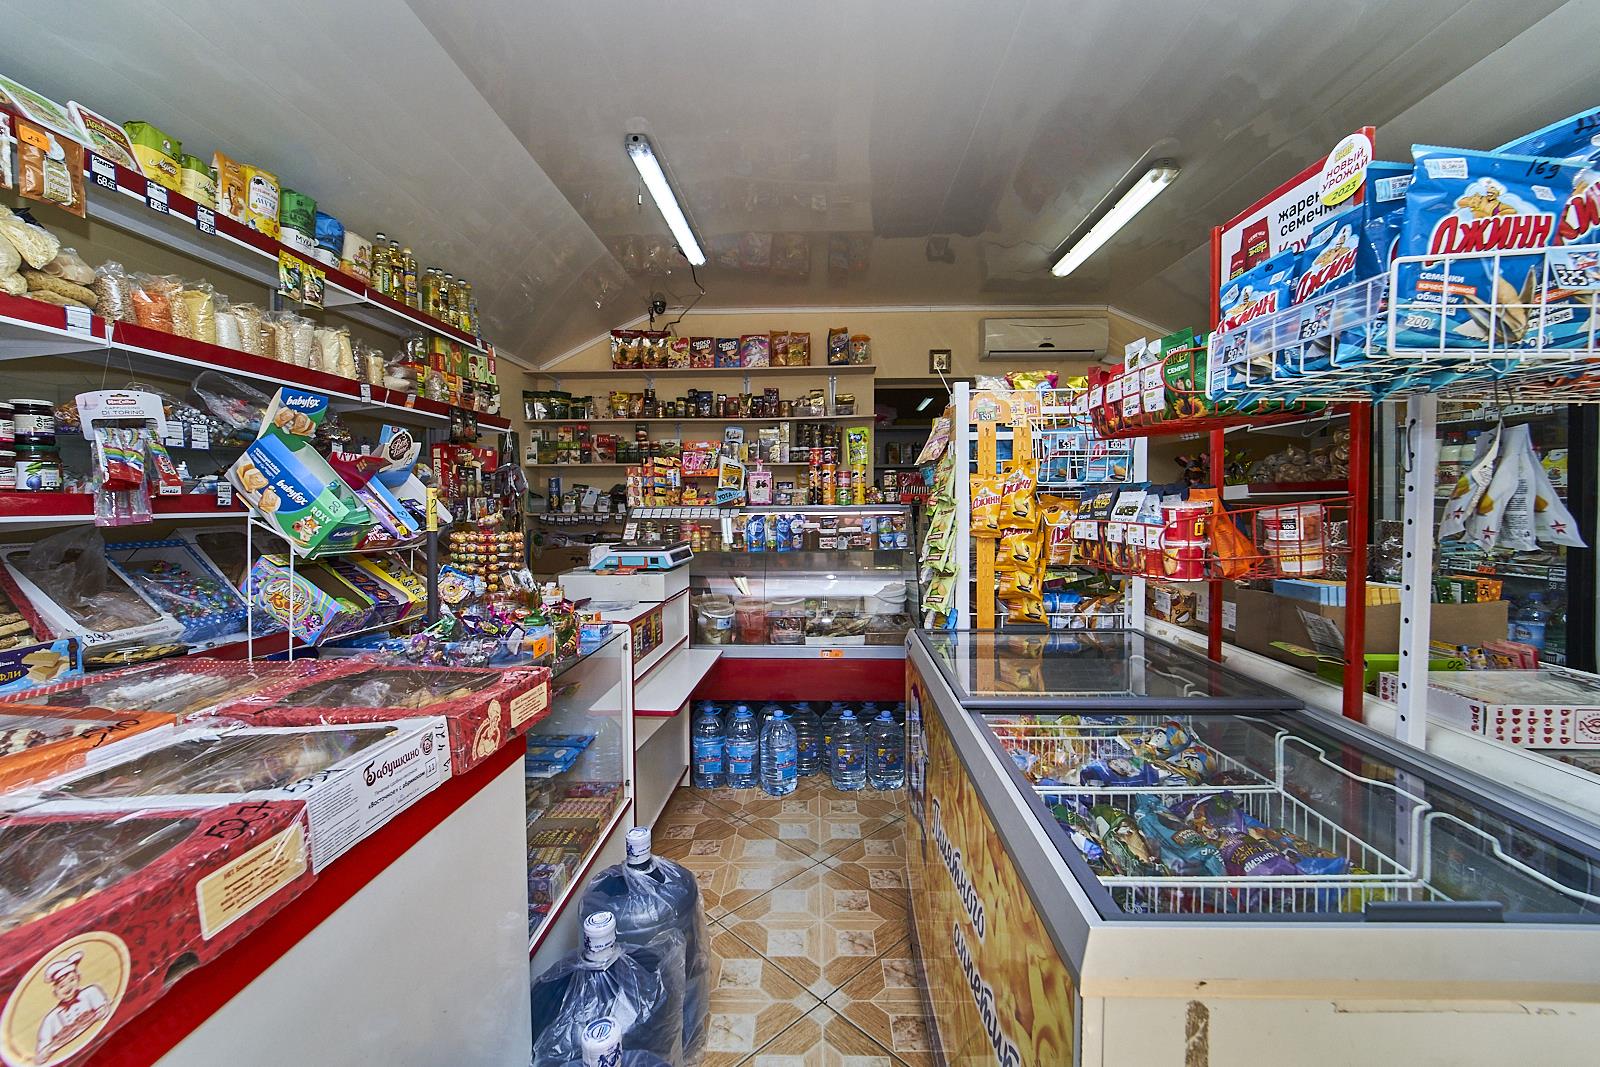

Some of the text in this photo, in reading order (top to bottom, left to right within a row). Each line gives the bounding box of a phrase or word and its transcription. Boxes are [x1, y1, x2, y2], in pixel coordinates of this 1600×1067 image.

[1322, 155, 1368, 192] УРОЖАЙ
[1326, 147, 1365, 180] НОВЫЙ
[1331, 180, 1357, 201] 2023
[1424, 213, 1553, 267] Джинн
[1420, 272, 1464, 283] семеки
[1215, 292, 1276, 335] Джинн
[286, 395, 321, 408] babyfox
[275, 478, 309, 507] babyfox
[310, 506, 333, 525] ROXY
[363, 748, 420, 787] Бабушкино
[931, 799, 985, 939] Приятного
